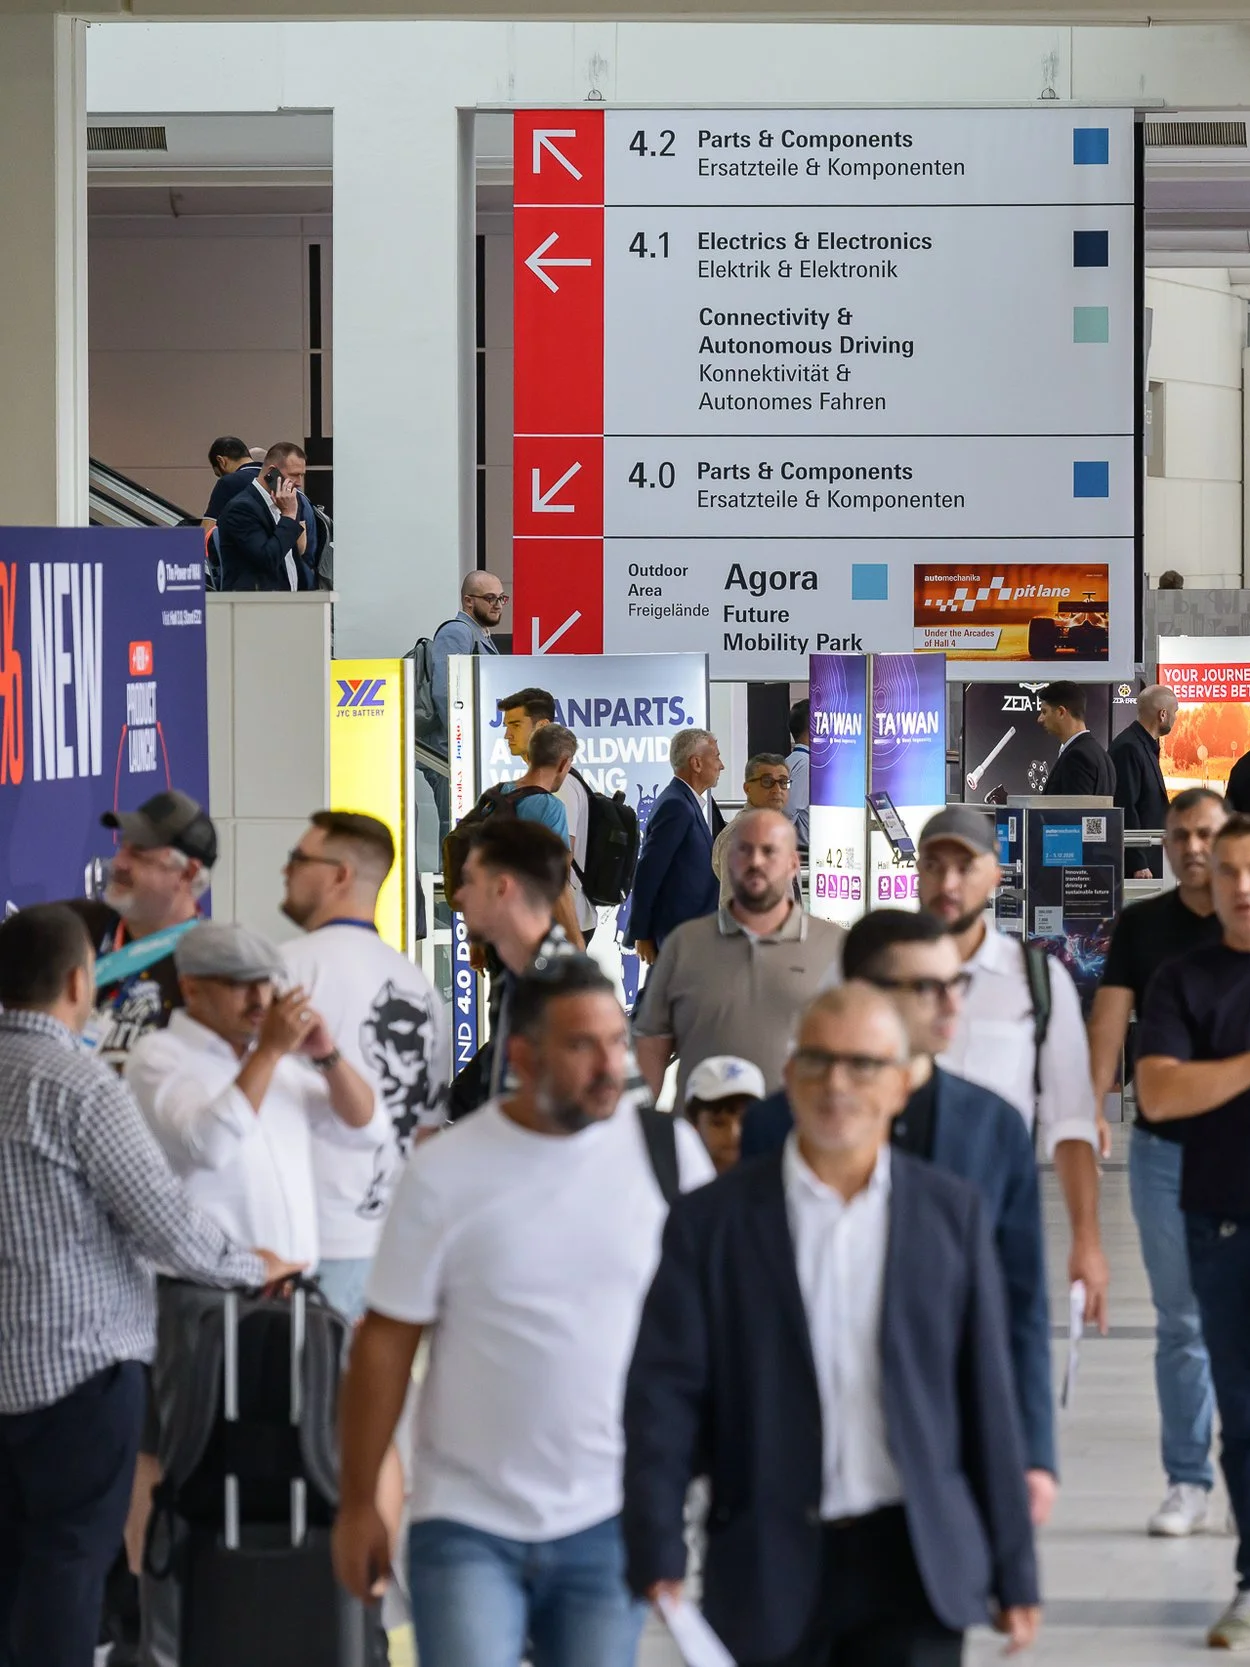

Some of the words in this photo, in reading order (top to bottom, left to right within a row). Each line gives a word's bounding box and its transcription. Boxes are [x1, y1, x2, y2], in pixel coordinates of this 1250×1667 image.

[629, 130, 676, 157] 4.2
[698, 130, 751, 148] Parts
[758, 130, 775, 148] &
[781, 130, 913, 152] Components
[698, 158, 799, 177] Ersatzteile
[805, 158, 821, 176] &
[828, 158, 965, 180] Komponenten
[628, 232, 669, 259] 4.1
[698, 231, 787, 250] Electrics
[794, 231, 810, 250] &
[817, 231, 932, 250] Electronics
[698, 259, 771, 278] Elektrik
[777, 259, 793, 278] &
[800, 259, 898, 278] Elektronik
[699, 307, 830, 330] Connectivity
[837, 307, 853, 326] &
[698, 335, 832, 354] Autonomous
[840, 335, 914, 358] Driving
[699, 363, 830, 383] Konnektivität
[836, 363, 852, 382] &
[698, 392, 812, 411] Autonomes
[820, 392, 886, 411] Fahren
[628, 461, 676, 489] 4.0
[697, 461, 751, 480] Parts
[757, 461, 774, 480] &
[780, 461, 913, 485] Components
[698, 489, 798, 508] Ersatzteile
[805, 489, 821, 508] &
[827, 489, 965, 512] Komponenten
[628, 563, 689, 577] Outdoor
[724, 563, 818, 592] Agora
[924, 574, 981, 582] automechanika
[627, 583, 662, 597] Area
[1013, 584, 1036, 600] pit
[1037, 584, 1071, 598] lane
[628, 603, 710, 620] Freigelände
[723, 604, 790, 623] Future
[723, 632, 810, 654] Mobility
[816, 633, 863, 651] Park
[924, 629, 949, 638] Under
[949, 629, 962, 638] the
[963, 629, 995, 638] Arcades
[924, 639, 933, 648] of
[933, 639, 949, 648] Hall
[950, 639, 956, 648] 4
[29, 562, 103, 782] NEW
[1164, 668, 1199, 682] YOUR
[336, 709, 350, 718] JYC
[352, 708, 385, 717] BATTERY
[814, 711, 862, 736] TAIWAN
[875, 710, 939, 736] TAIWAN
[489, 736, 512, 765] A
[457, 969, 472, 1015] 4.0
